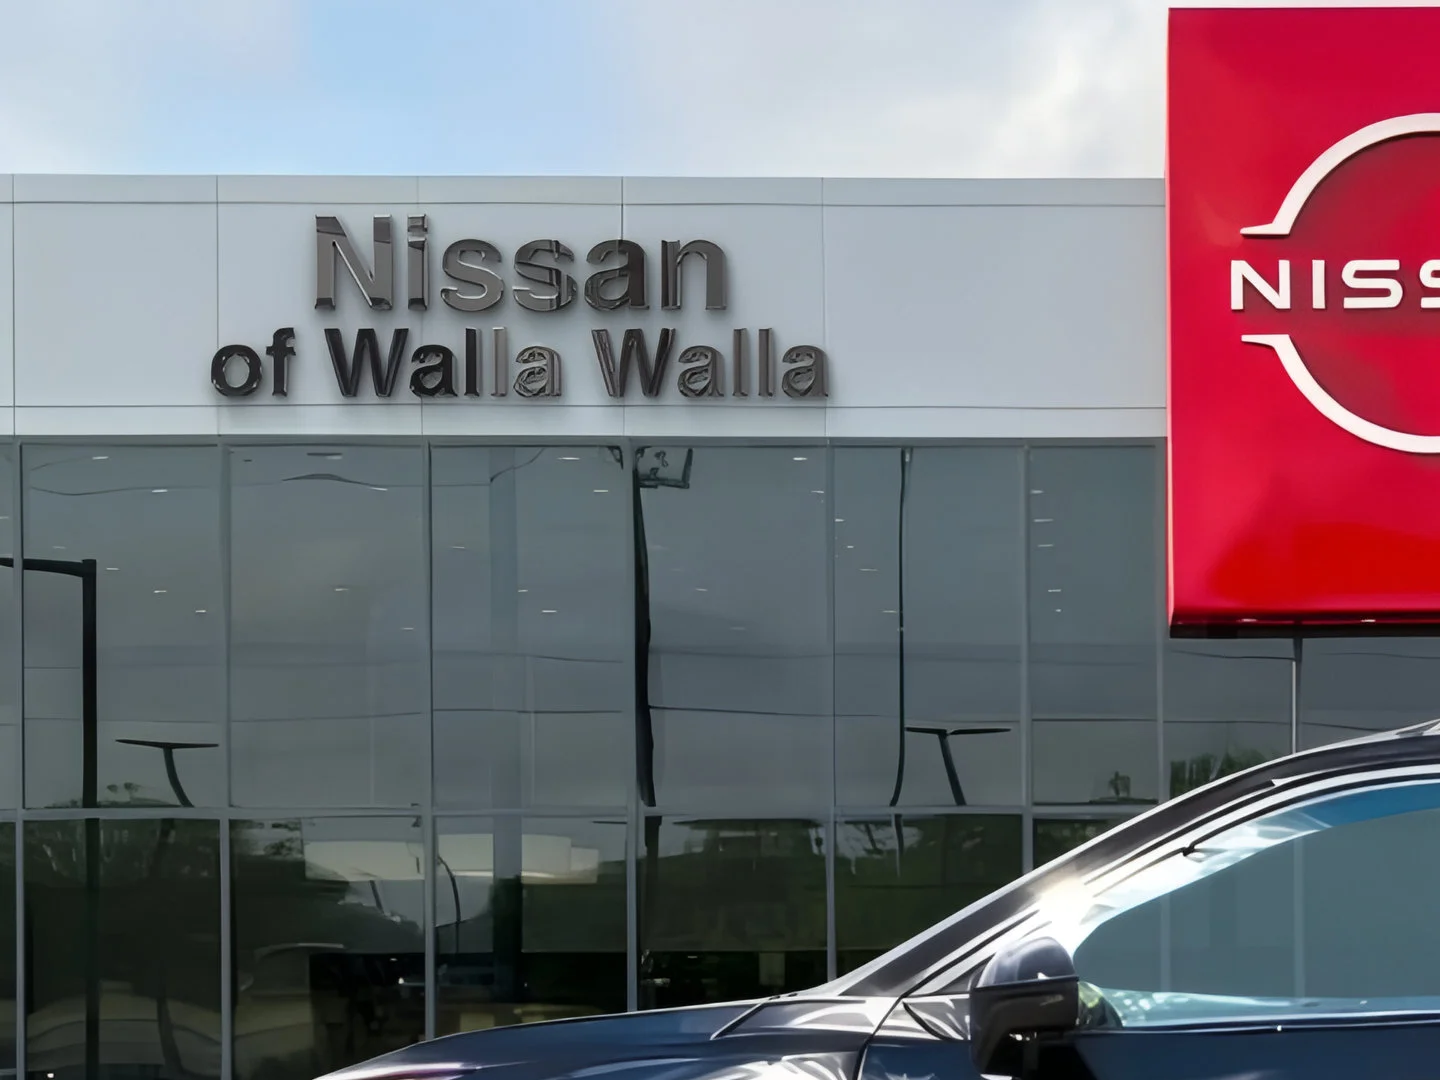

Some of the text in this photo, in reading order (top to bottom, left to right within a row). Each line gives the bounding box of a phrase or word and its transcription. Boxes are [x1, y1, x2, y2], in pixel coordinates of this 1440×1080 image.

[314, 213, 728, 312] Nissan
[211, 327, 829, 398] of Walla Walla
